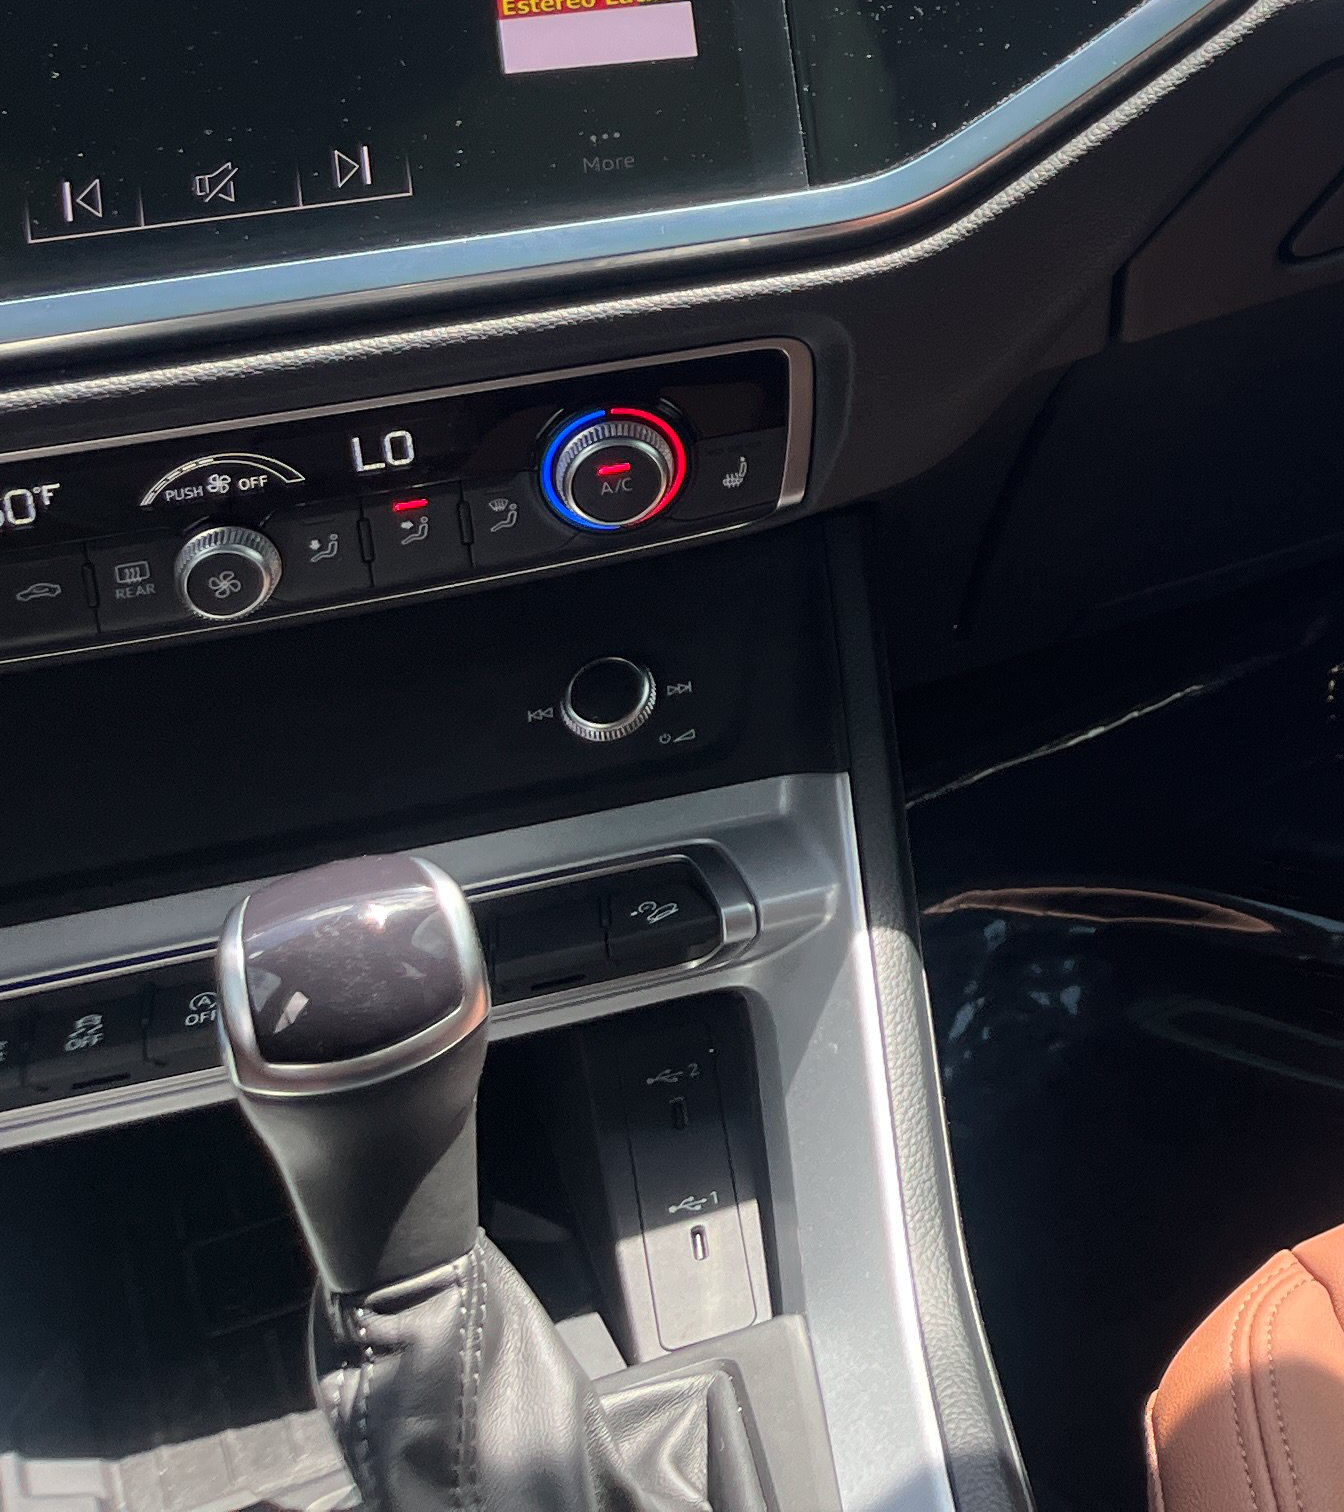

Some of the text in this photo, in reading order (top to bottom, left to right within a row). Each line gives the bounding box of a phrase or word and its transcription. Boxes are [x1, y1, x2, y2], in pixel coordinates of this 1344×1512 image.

[582, 155, 635, 174] More
[351, 430, 415, 472] LO
[165, 474, 269, 502] PUSH OFF
[600, 476, 633, 496] A/C
[0, 482, 61, 526] 0°F
[115, 583, 156, 600] REAR
[64, 1032, 104, 1052] OFF
